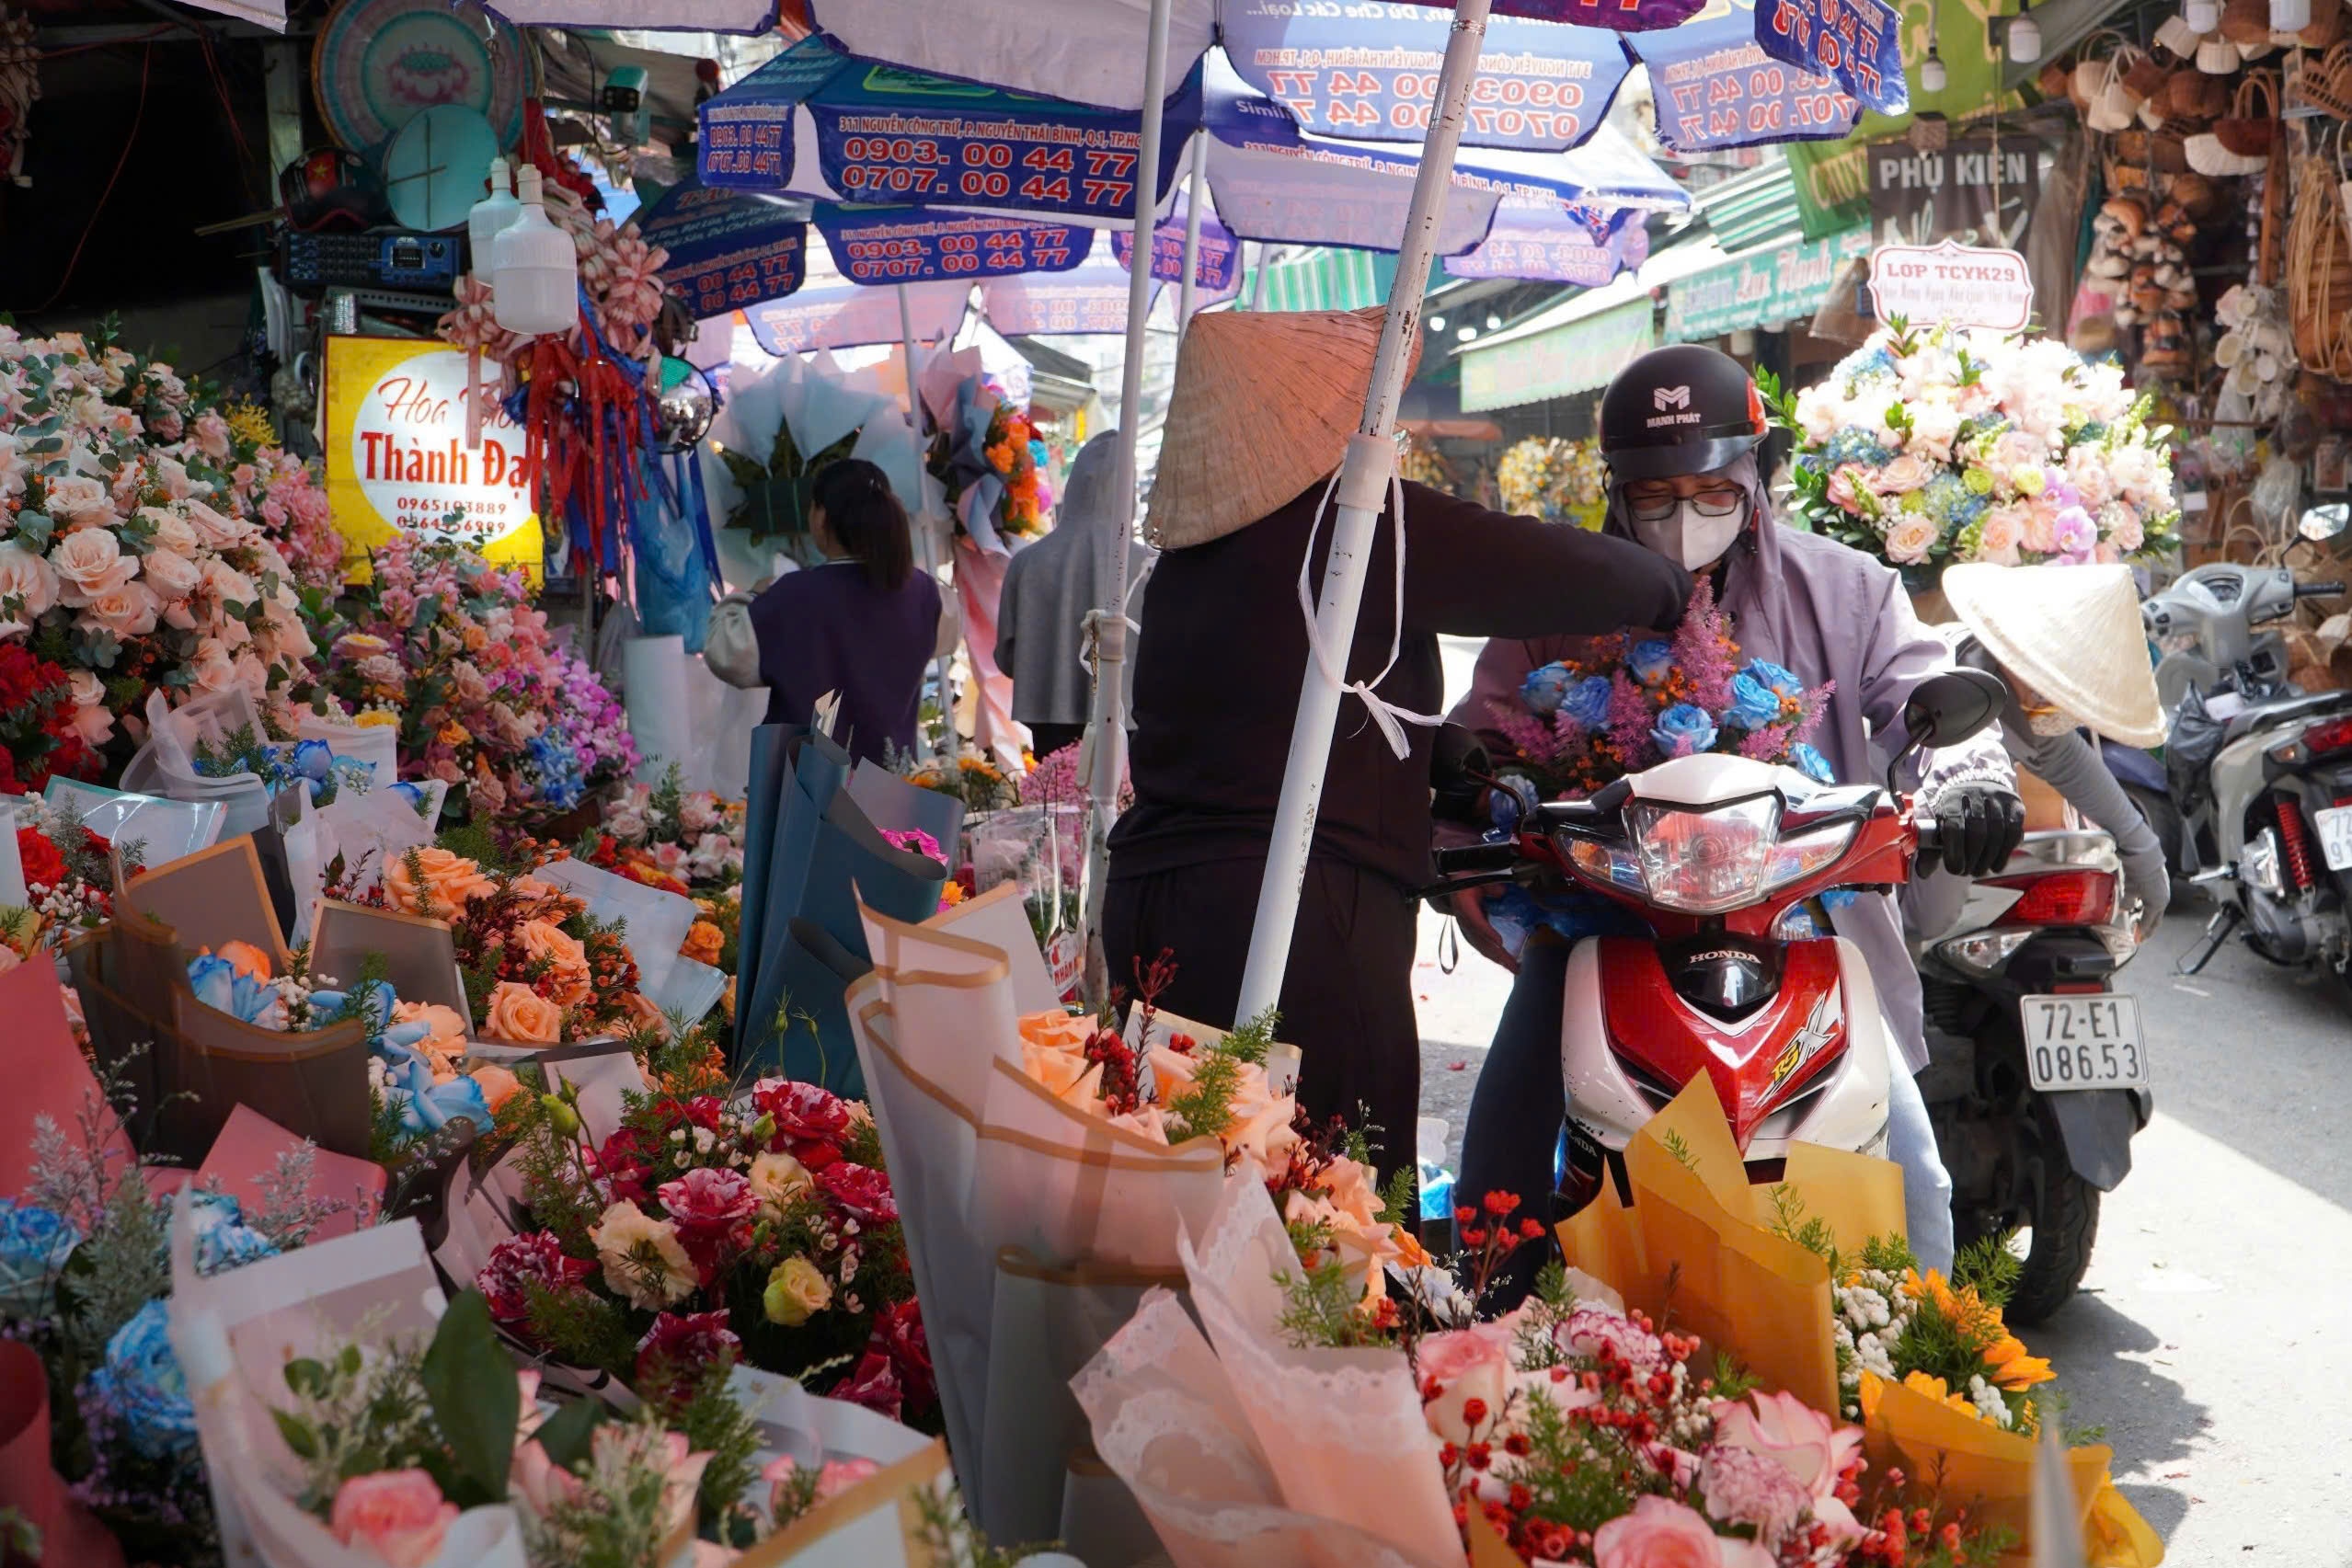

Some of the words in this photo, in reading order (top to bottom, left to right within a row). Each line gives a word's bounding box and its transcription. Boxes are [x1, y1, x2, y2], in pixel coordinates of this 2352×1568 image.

[839, 116, 859, 132] 311
[906, 116, 936, 135] CÔNG
[1023, 122, 1050, 143] THÁI
[844, 137, 950, 166] 0903.
[963, 143, 1012, 167] 00
[1023, 147, 1074, 172] 44
[1085, 151, 1137, 177] 77
[842, 166, 948, 194] 0707.
[960, 171, 1010, 197] 00
[1020, 176, 1071, 202] 44
[1083, 180, 1132, 207] 77
[847, 238, 932, 259] 0903.
[939, 235, 977, 253] 00
[984, 232, 1024, 249] 44
[1030, 229, 1069, 246] 77
[760, 254, 790, 275] 77
[851, 258, 935, 278] 0707.
[941, 254, 979, 272] 00
[987, 249, 1024, 268] 44
[1031, 249, 1070, 266] 77
[764, 272, 795, 294] 77
[377, 377, 450, 424] Hoa
[361, 431, 468, 486] Thành
[482, 439, 531, 499] Đạ
[1689, 950, 1761, 964] HONDA
[2040, 1001, 2120, 1040] 72-E1
[2036, 1044, 2139, 1082] 086.53
